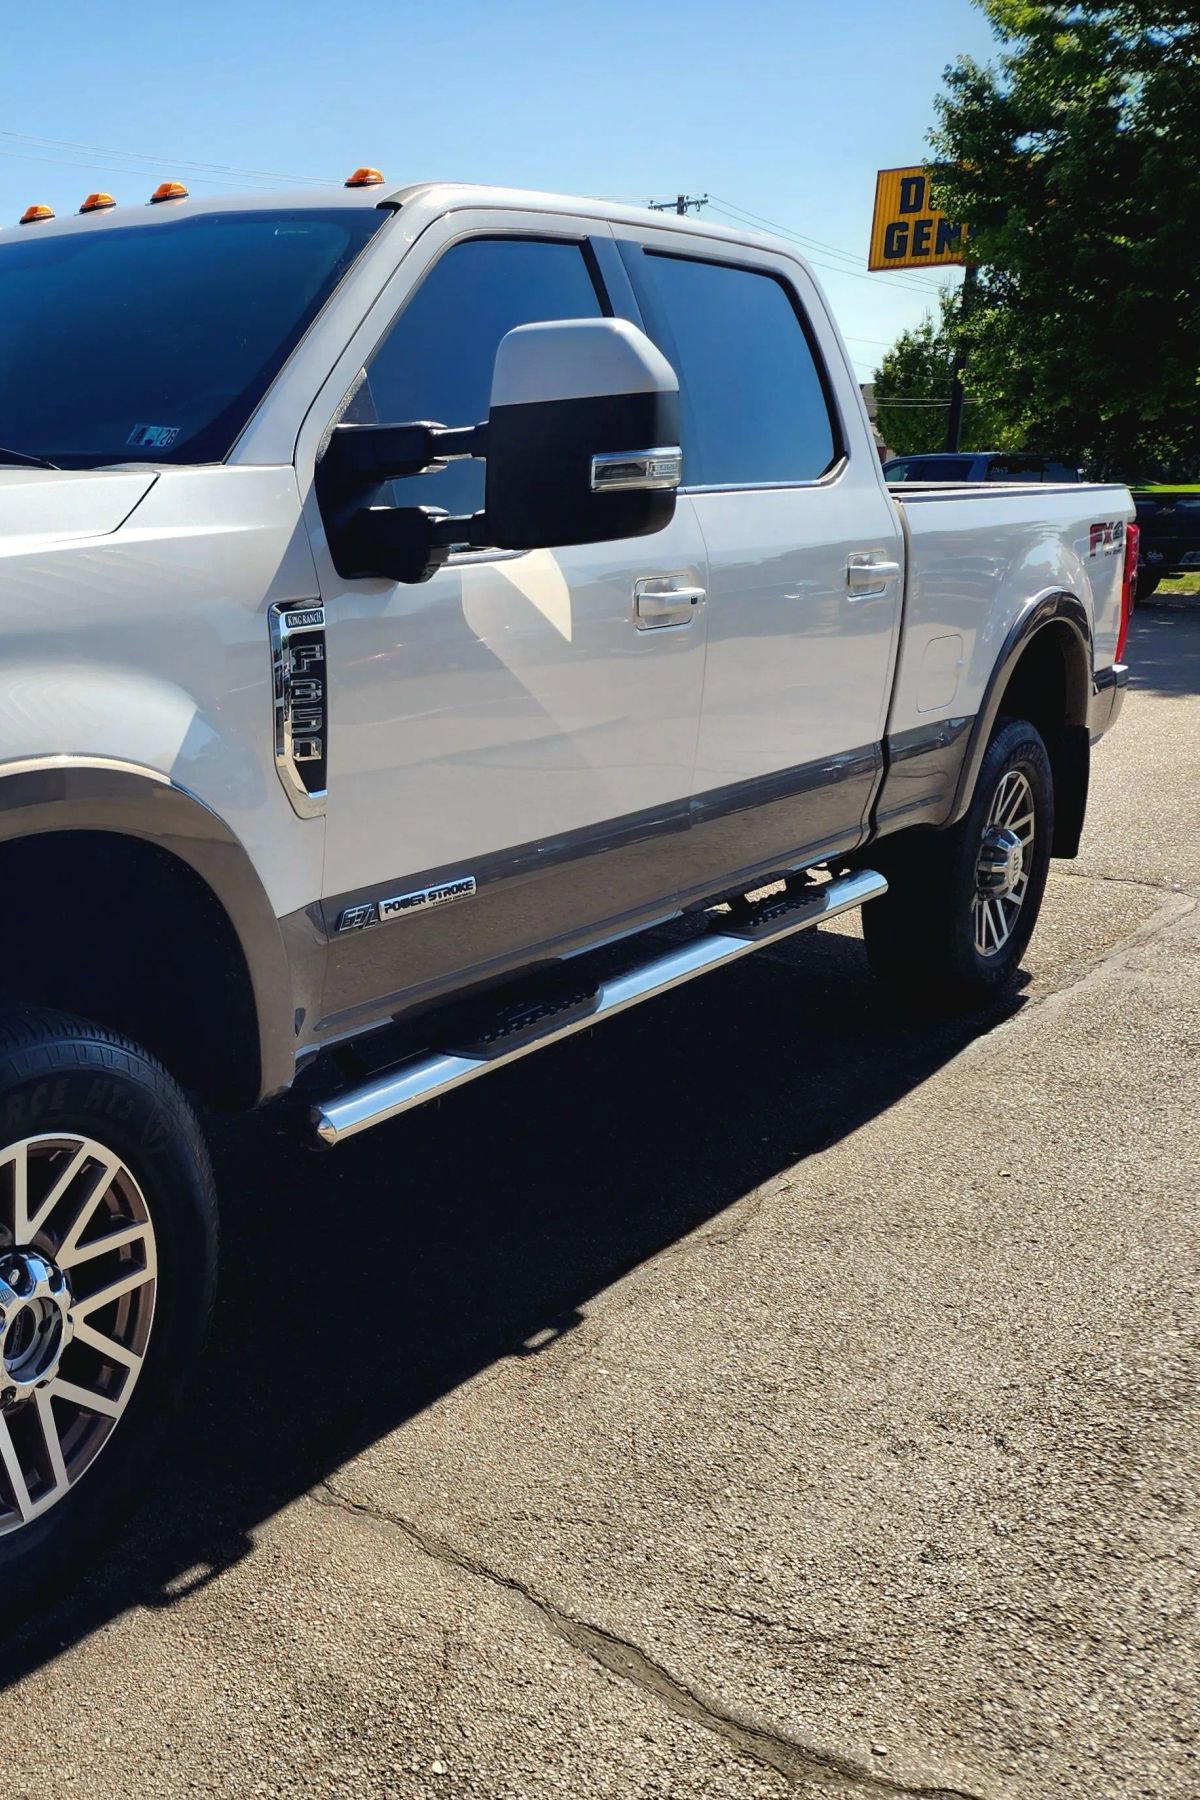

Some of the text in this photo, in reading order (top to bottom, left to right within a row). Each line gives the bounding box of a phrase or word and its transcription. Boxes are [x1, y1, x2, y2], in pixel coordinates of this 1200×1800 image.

[1089, 521, 1123, 557] FX4
[287, 611, 322, 627] KING RANCH
[384, 895, 426, 914] POWER
[428, 879, 474, 901] STROKE
